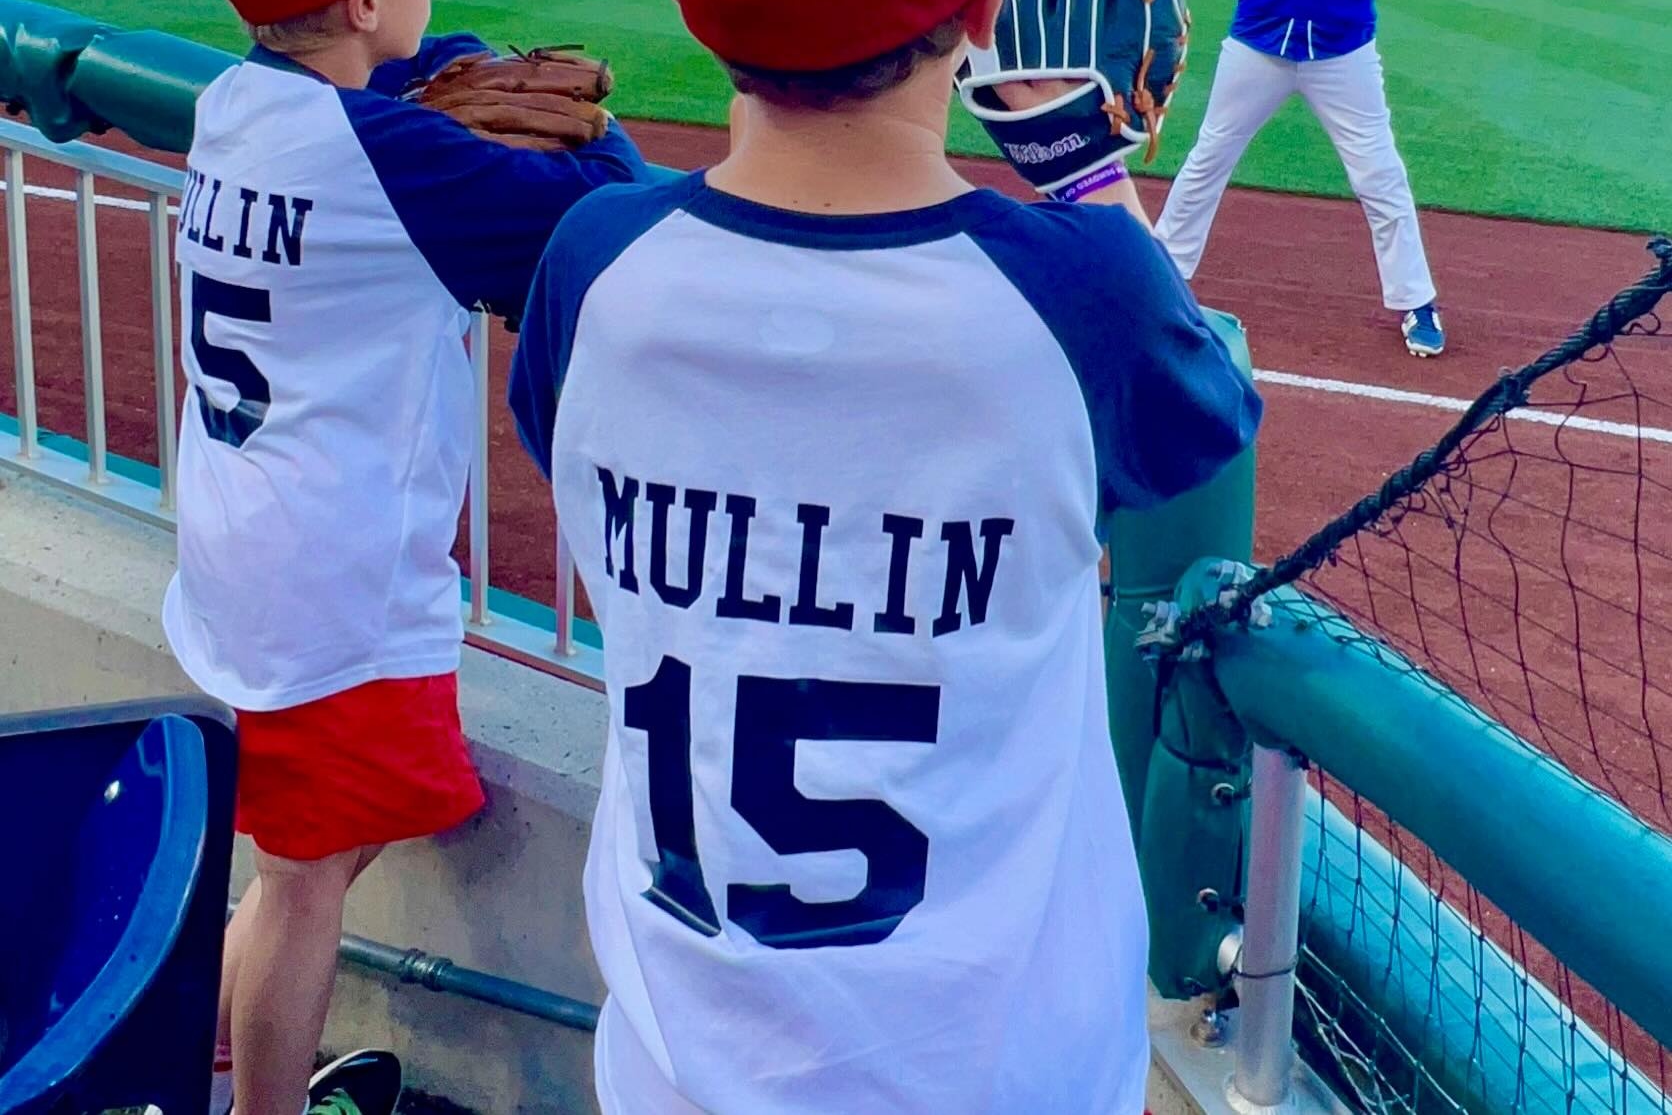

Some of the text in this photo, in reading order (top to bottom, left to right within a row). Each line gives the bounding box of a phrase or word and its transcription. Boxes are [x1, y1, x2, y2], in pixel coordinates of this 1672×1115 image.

[1003, 133, 1085, 164] Wilson
[594, 464, 1015, 638] MULLIN
[624, 654, 941, 950] 15
